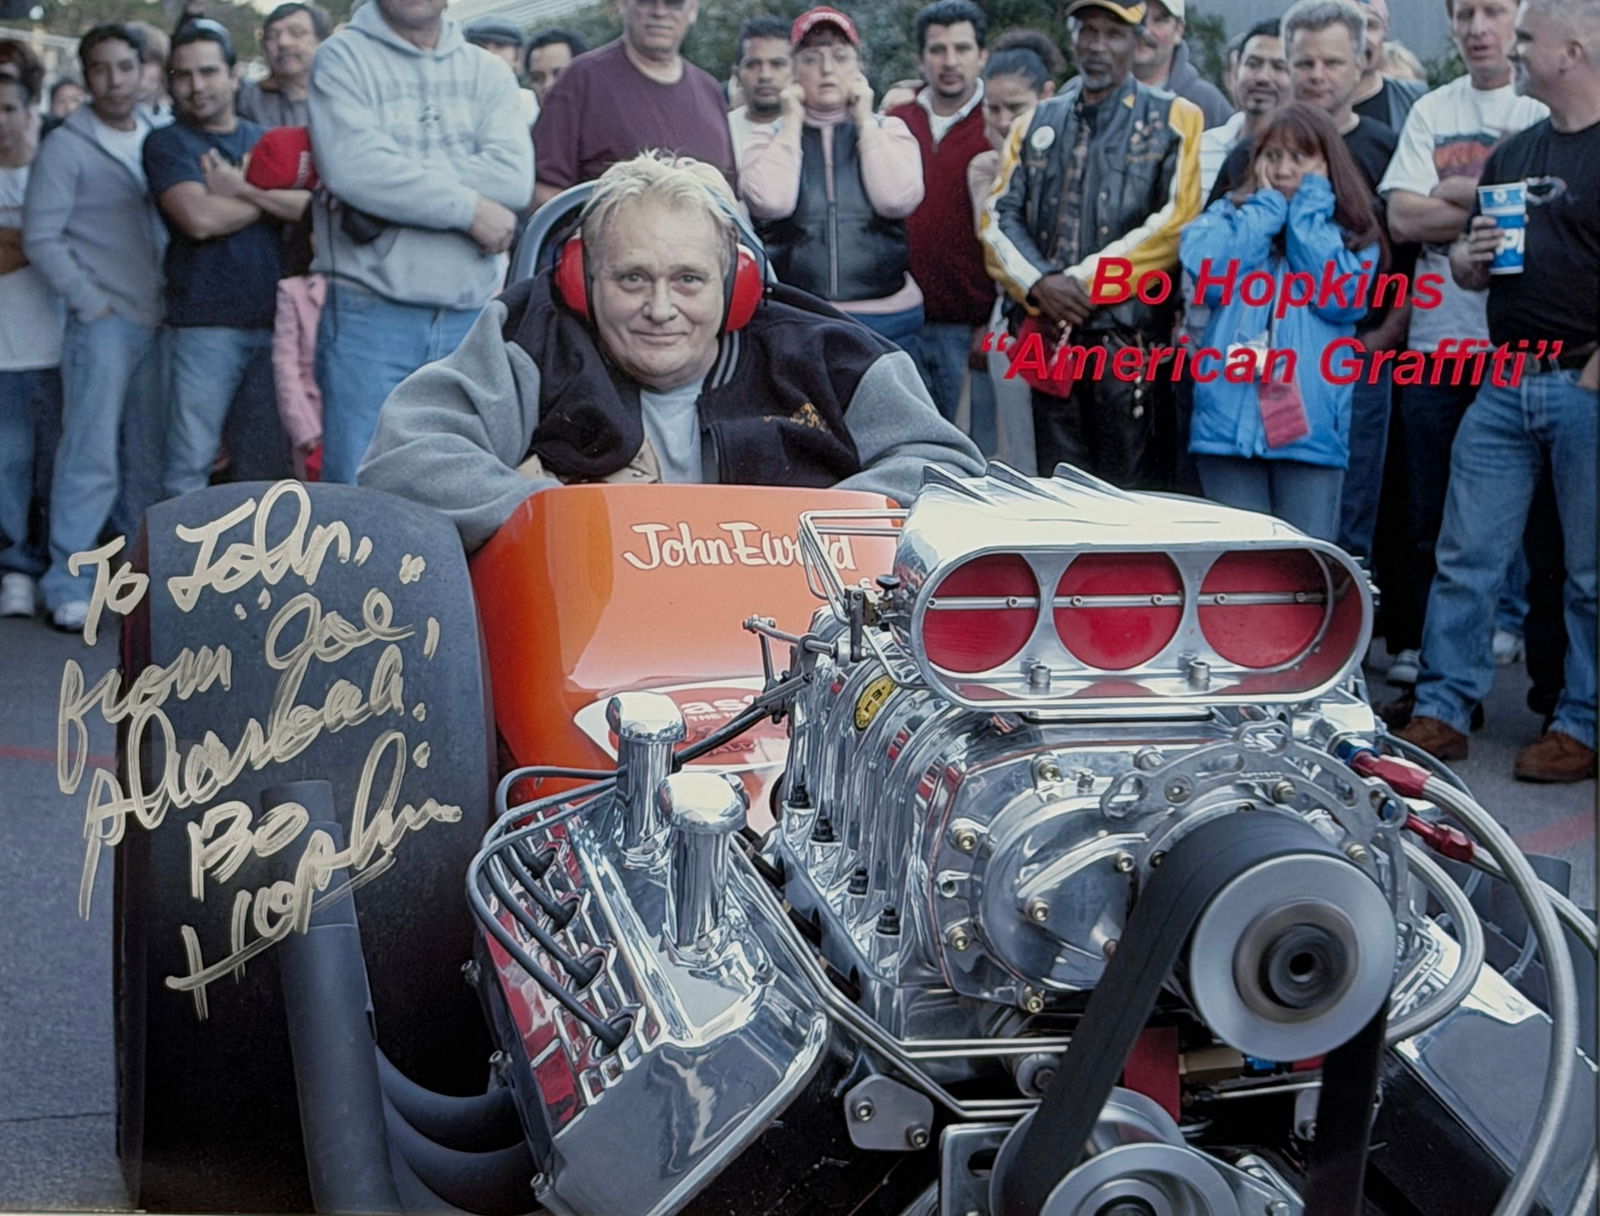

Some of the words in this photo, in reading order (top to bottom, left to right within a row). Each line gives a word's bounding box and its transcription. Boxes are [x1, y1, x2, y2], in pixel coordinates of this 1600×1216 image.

[68, 535, 150, 646] To
[716, 522, 857, 571] Ewd
[57, 645, 232, 794] from
[165, 731, 462, 1021] Hopkins
[187, 801, 309, 902] Bo
